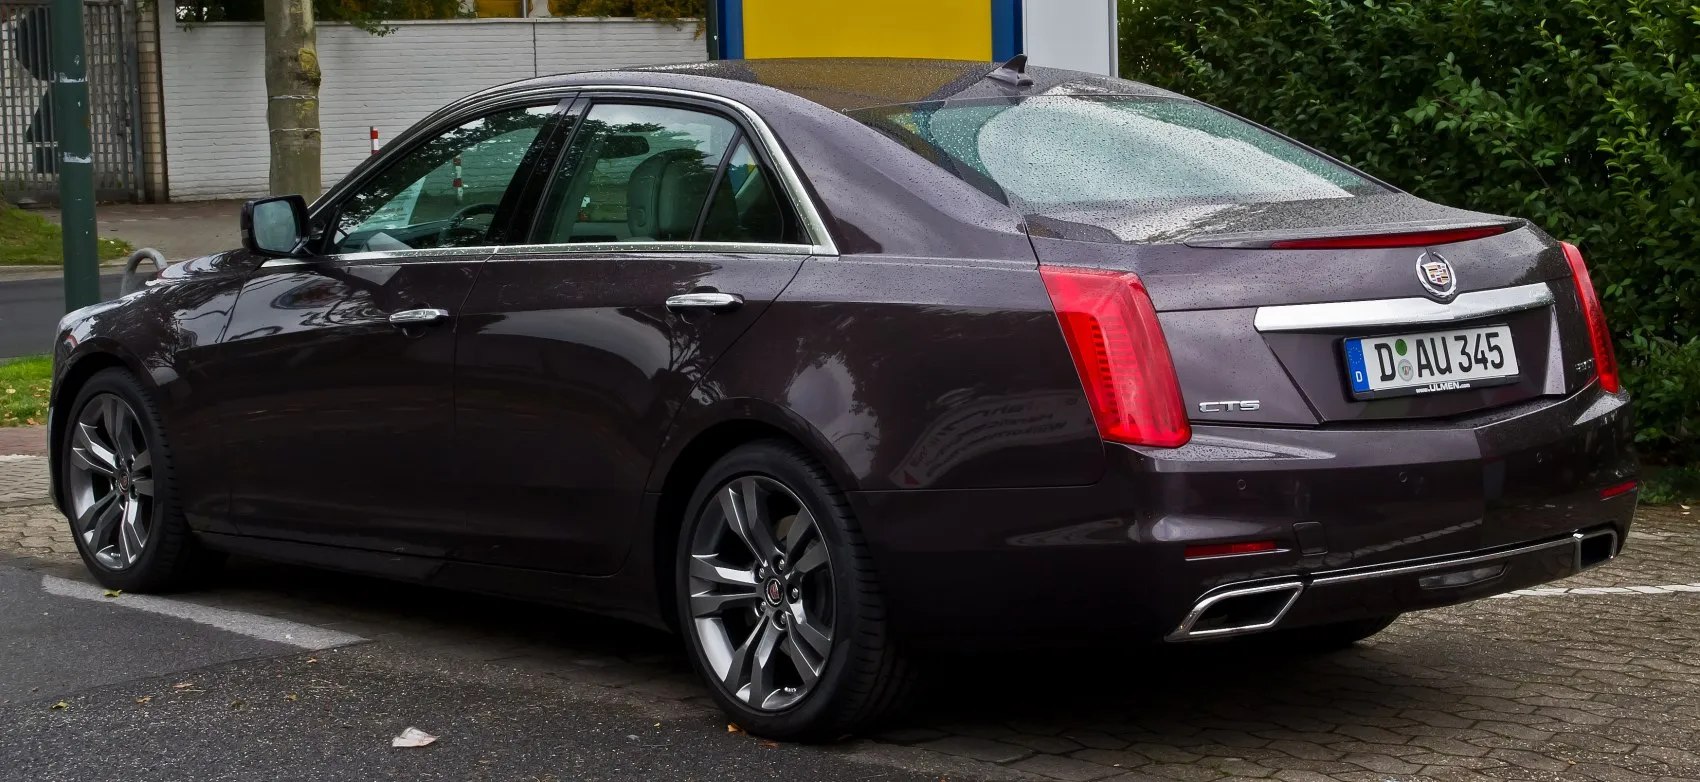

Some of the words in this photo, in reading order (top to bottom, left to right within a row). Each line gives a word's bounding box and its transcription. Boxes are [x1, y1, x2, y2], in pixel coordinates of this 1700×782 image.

[1374, 342, 1397, 382] D
[1415, 336, 1453, 378] AU
[1454, 331, 1505, 374] 345
[1355, 370, 1363, 383] D
[1199, 400, 1260, 412] CTS
